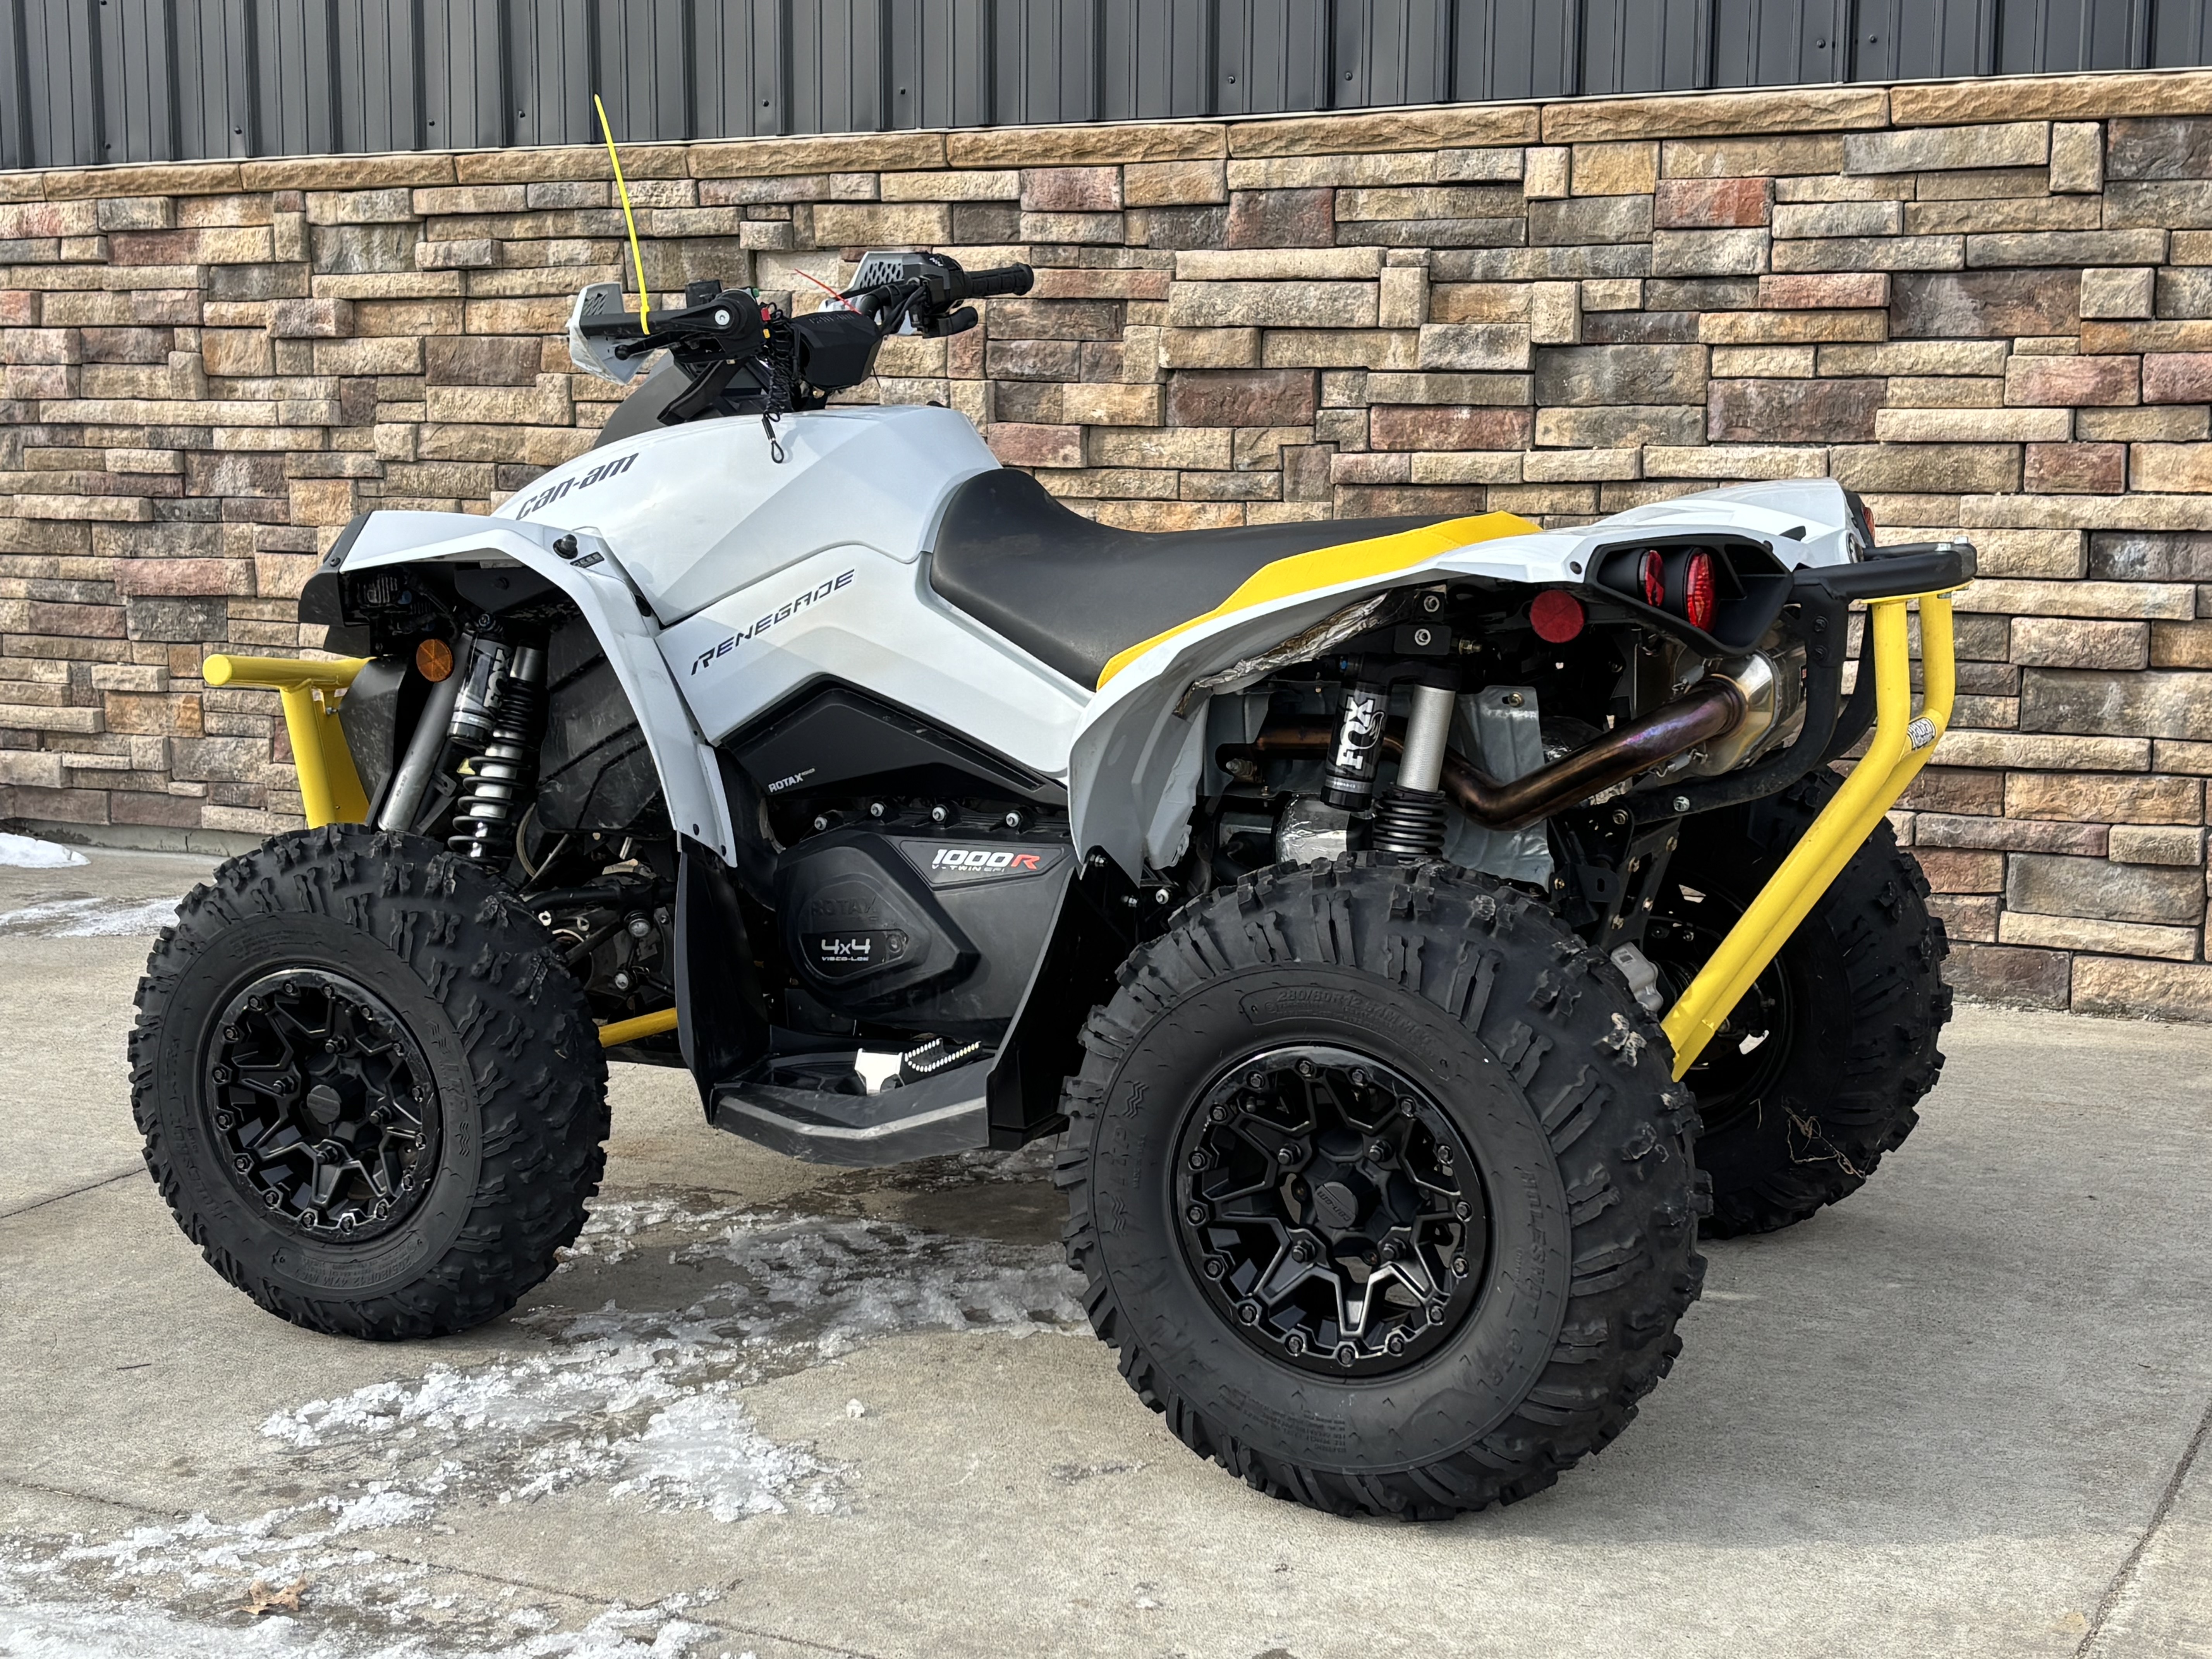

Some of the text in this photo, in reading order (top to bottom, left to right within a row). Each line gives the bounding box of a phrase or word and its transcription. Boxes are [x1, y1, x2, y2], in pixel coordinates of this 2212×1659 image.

[515, 452, 639, 520] can-am
[691, 568, 855, 676] RENEGADE
[1336, 696, 1384, 770] FOX
[768, 773, 804, 793] ROTAX
[821, 938, 871, 955] 4x4
[1317, 1190, 1351, 1222] can-am
